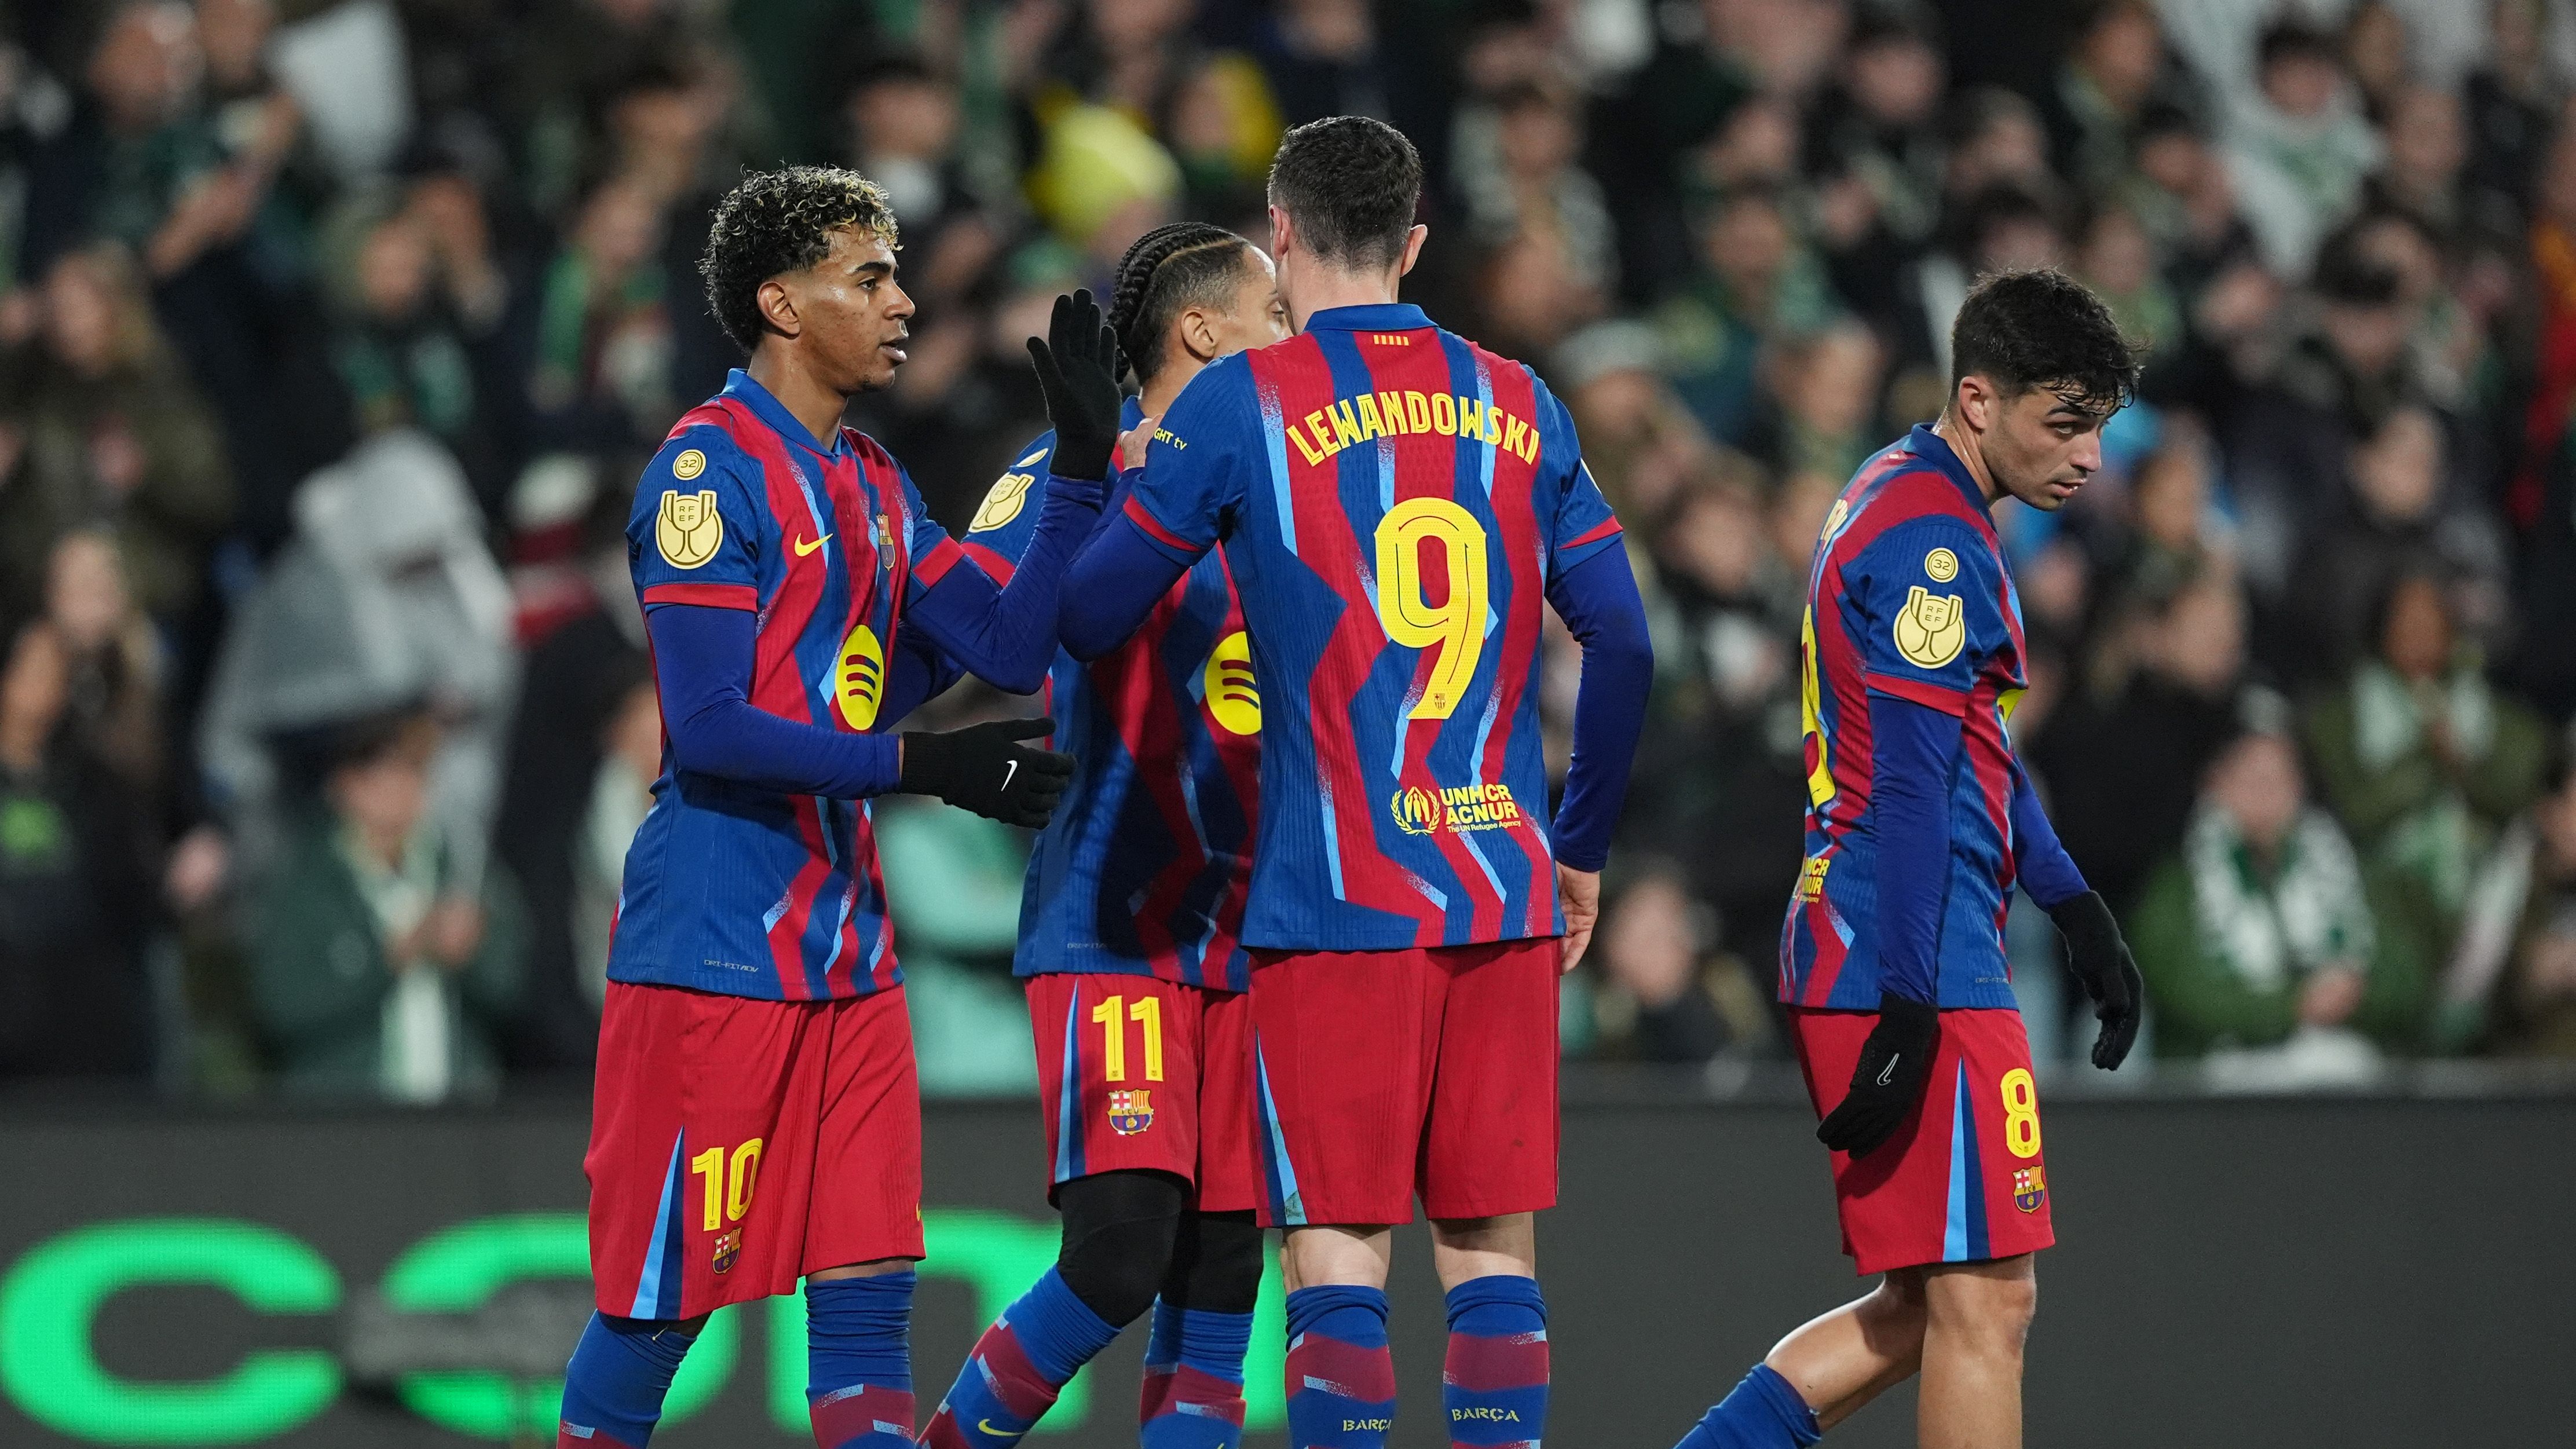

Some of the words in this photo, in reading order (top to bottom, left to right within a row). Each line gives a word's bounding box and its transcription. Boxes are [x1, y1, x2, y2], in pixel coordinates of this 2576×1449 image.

[1286, 390, 1540, 467] LEWANDOWSKI
[680, 459, 697, 468] 32
[1933, 559, 1951, 571] 32
[1374, 497, 1488, 719] 9
[1439, 784, 1513, 806] UNHCR
[1445, 802, 1520, 825] ACNUR
[1470, 823, 1498, 831] Refugee
[1498, 820, 1521, 829] Agency
[1092, 995, 1163, 1082] 11
[2000, 1067, 2041, 1158] 8
[692, 1137, 763, 1231] 10
[1451, 1407, 1520, 1422] BARÇA
